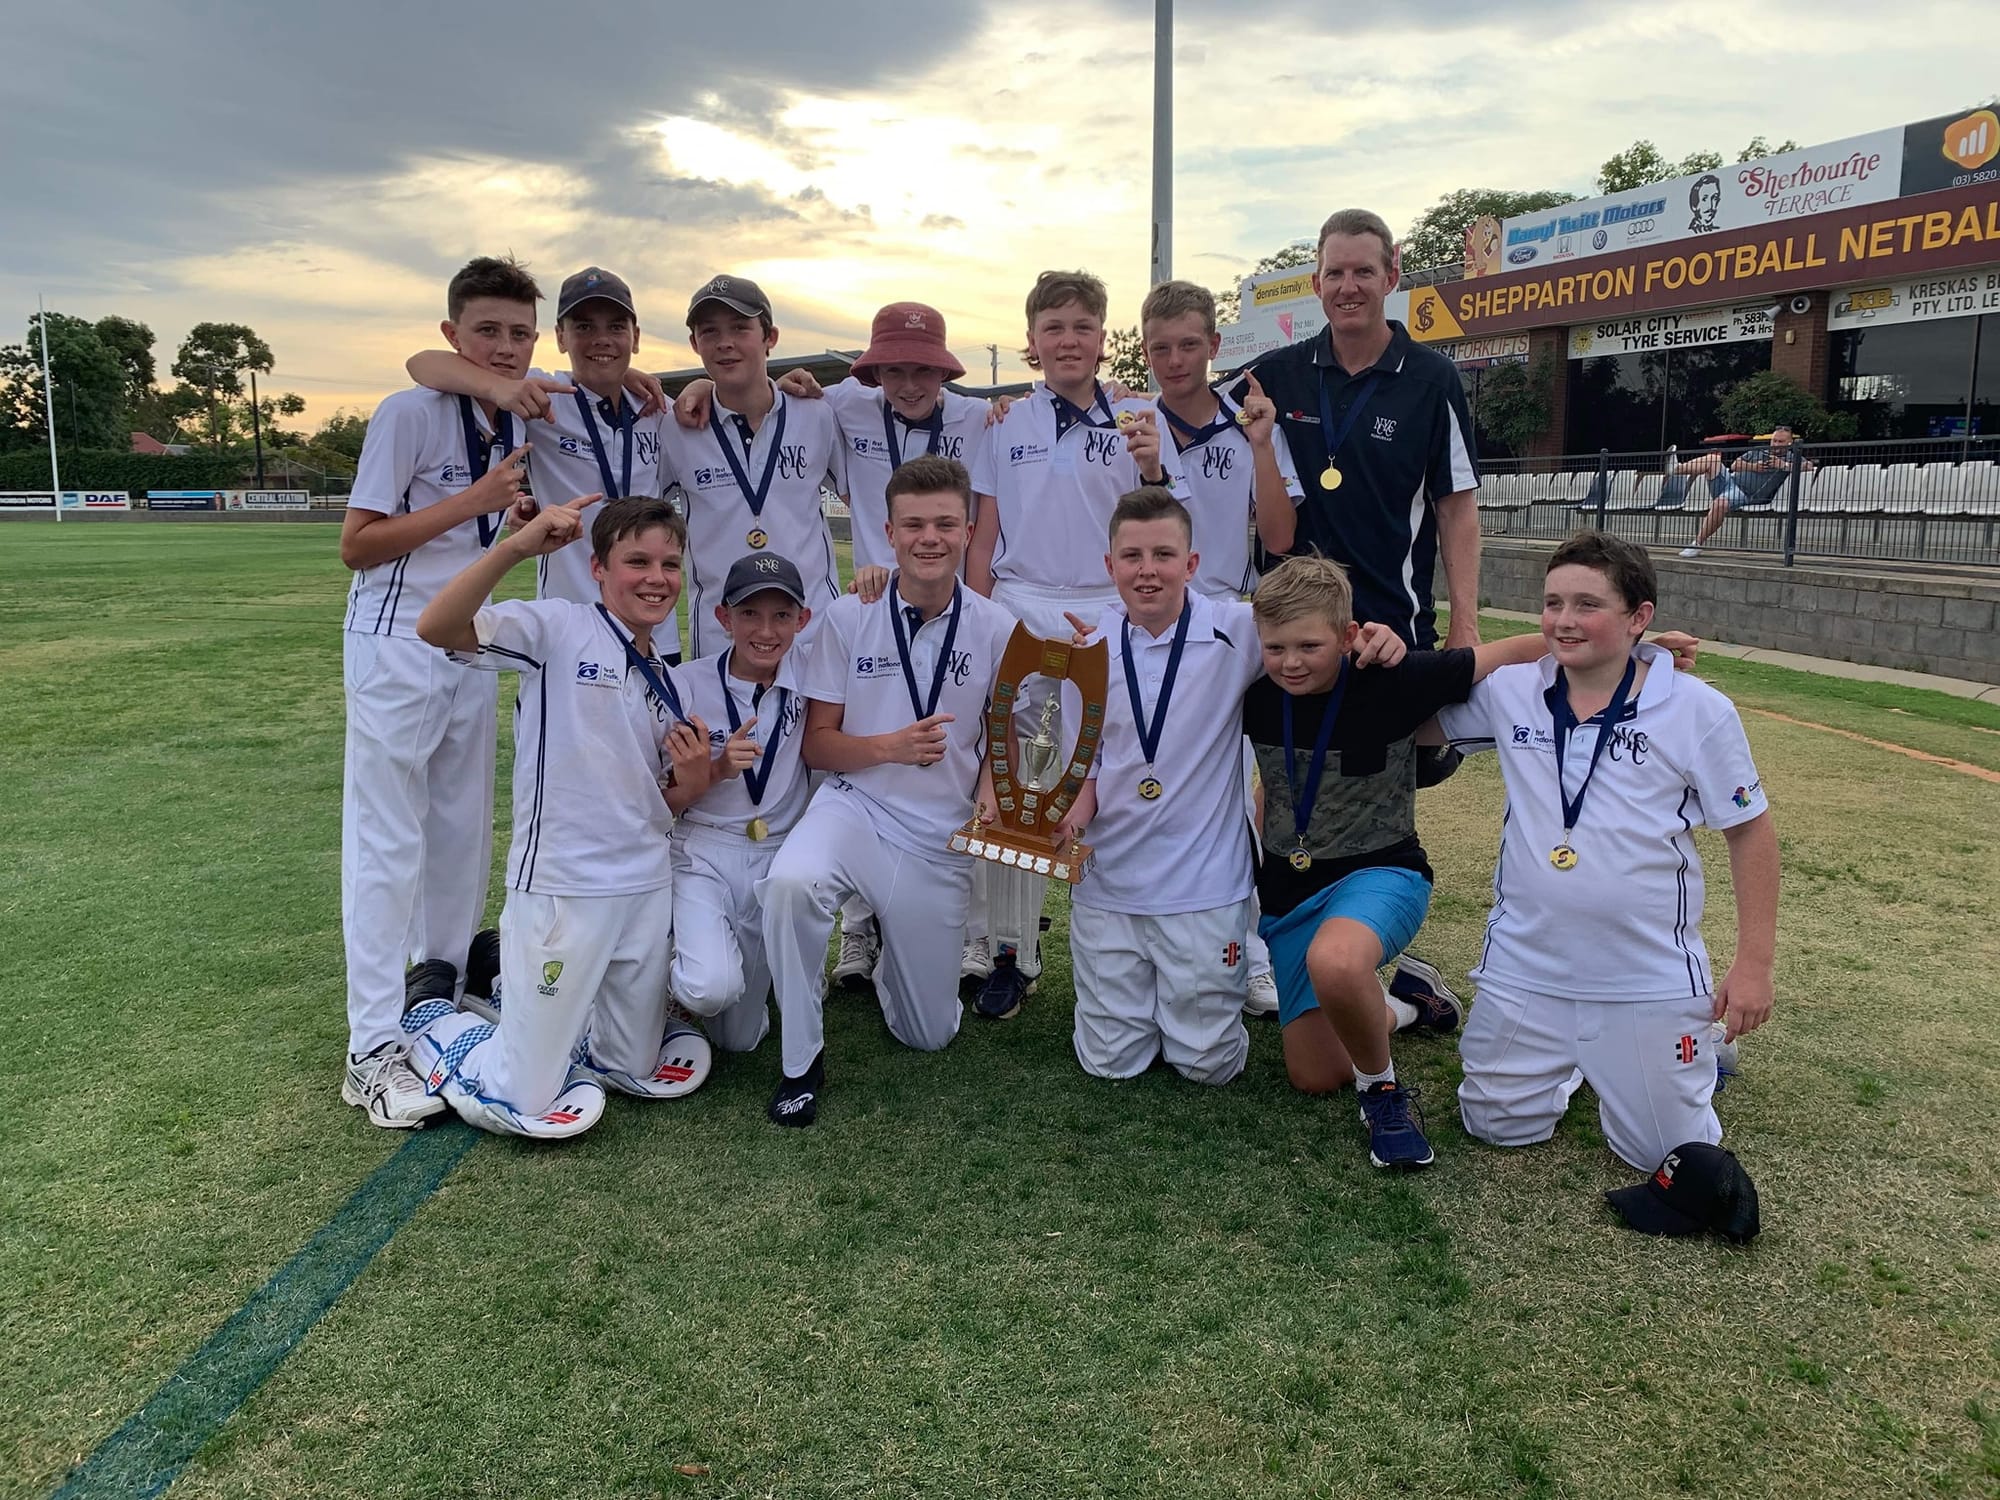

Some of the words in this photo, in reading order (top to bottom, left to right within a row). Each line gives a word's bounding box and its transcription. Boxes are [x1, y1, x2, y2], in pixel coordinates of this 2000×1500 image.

[1738, 152, 1880, 199] Sherbourne
[1952, 175, 1971, 187] (03)
[1972, 169, 1997, 183] 5820
[1602, 196, 1667, 227] Motors
[1763, 184, 1854, 216] TERRACE
[1459, 264, 1636, 322] SHEPPARTON
[1643, 232, 1827, 294] FOOTBALL
[1908, 276, 1978, 299] KRESKAS
[1256, 282, 1279, 300] dennis
[1912, 300, 1941, 316] PTY.
[1947, 295, 1976, 313] LTD.
[1596, 320, 1642, 339] SOLAR
[1647, 314, 1684, 332] CITY
[1622, 334, 1658, 351] TYRE
[1664, 324, 1728, 346] SERVICE
[1740, 325, 1756, 336] 24
[85, 494, 125, 503] DAF
